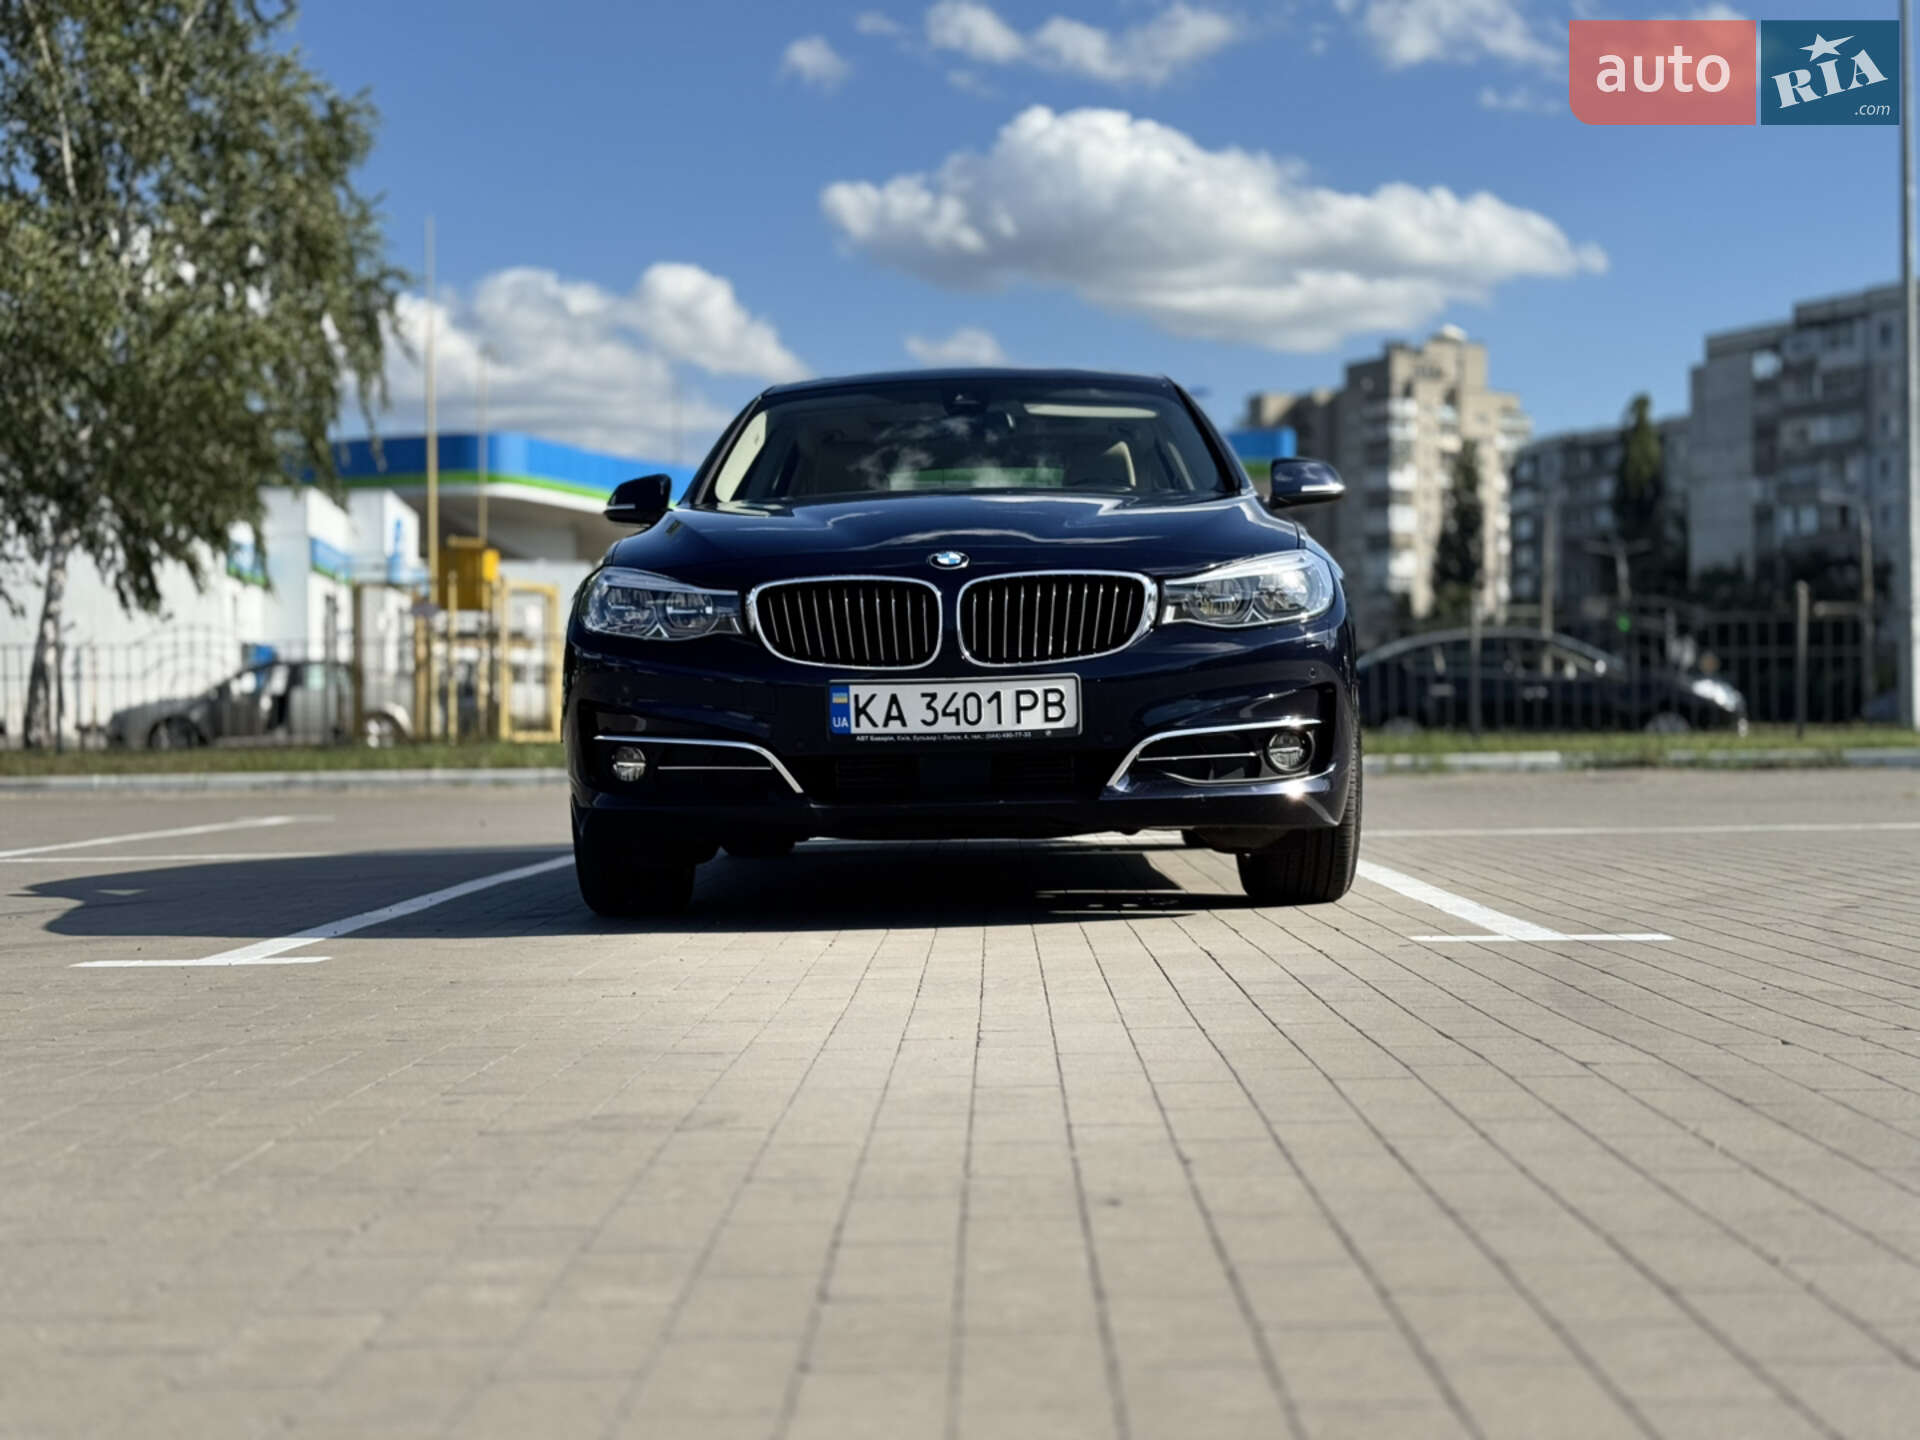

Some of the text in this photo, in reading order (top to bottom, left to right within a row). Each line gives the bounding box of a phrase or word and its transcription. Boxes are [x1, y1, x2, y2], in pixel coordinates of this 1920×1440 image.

[853, 687, 1066, 728] KA 3401 PB
[832, 716, 849, 728] UA
